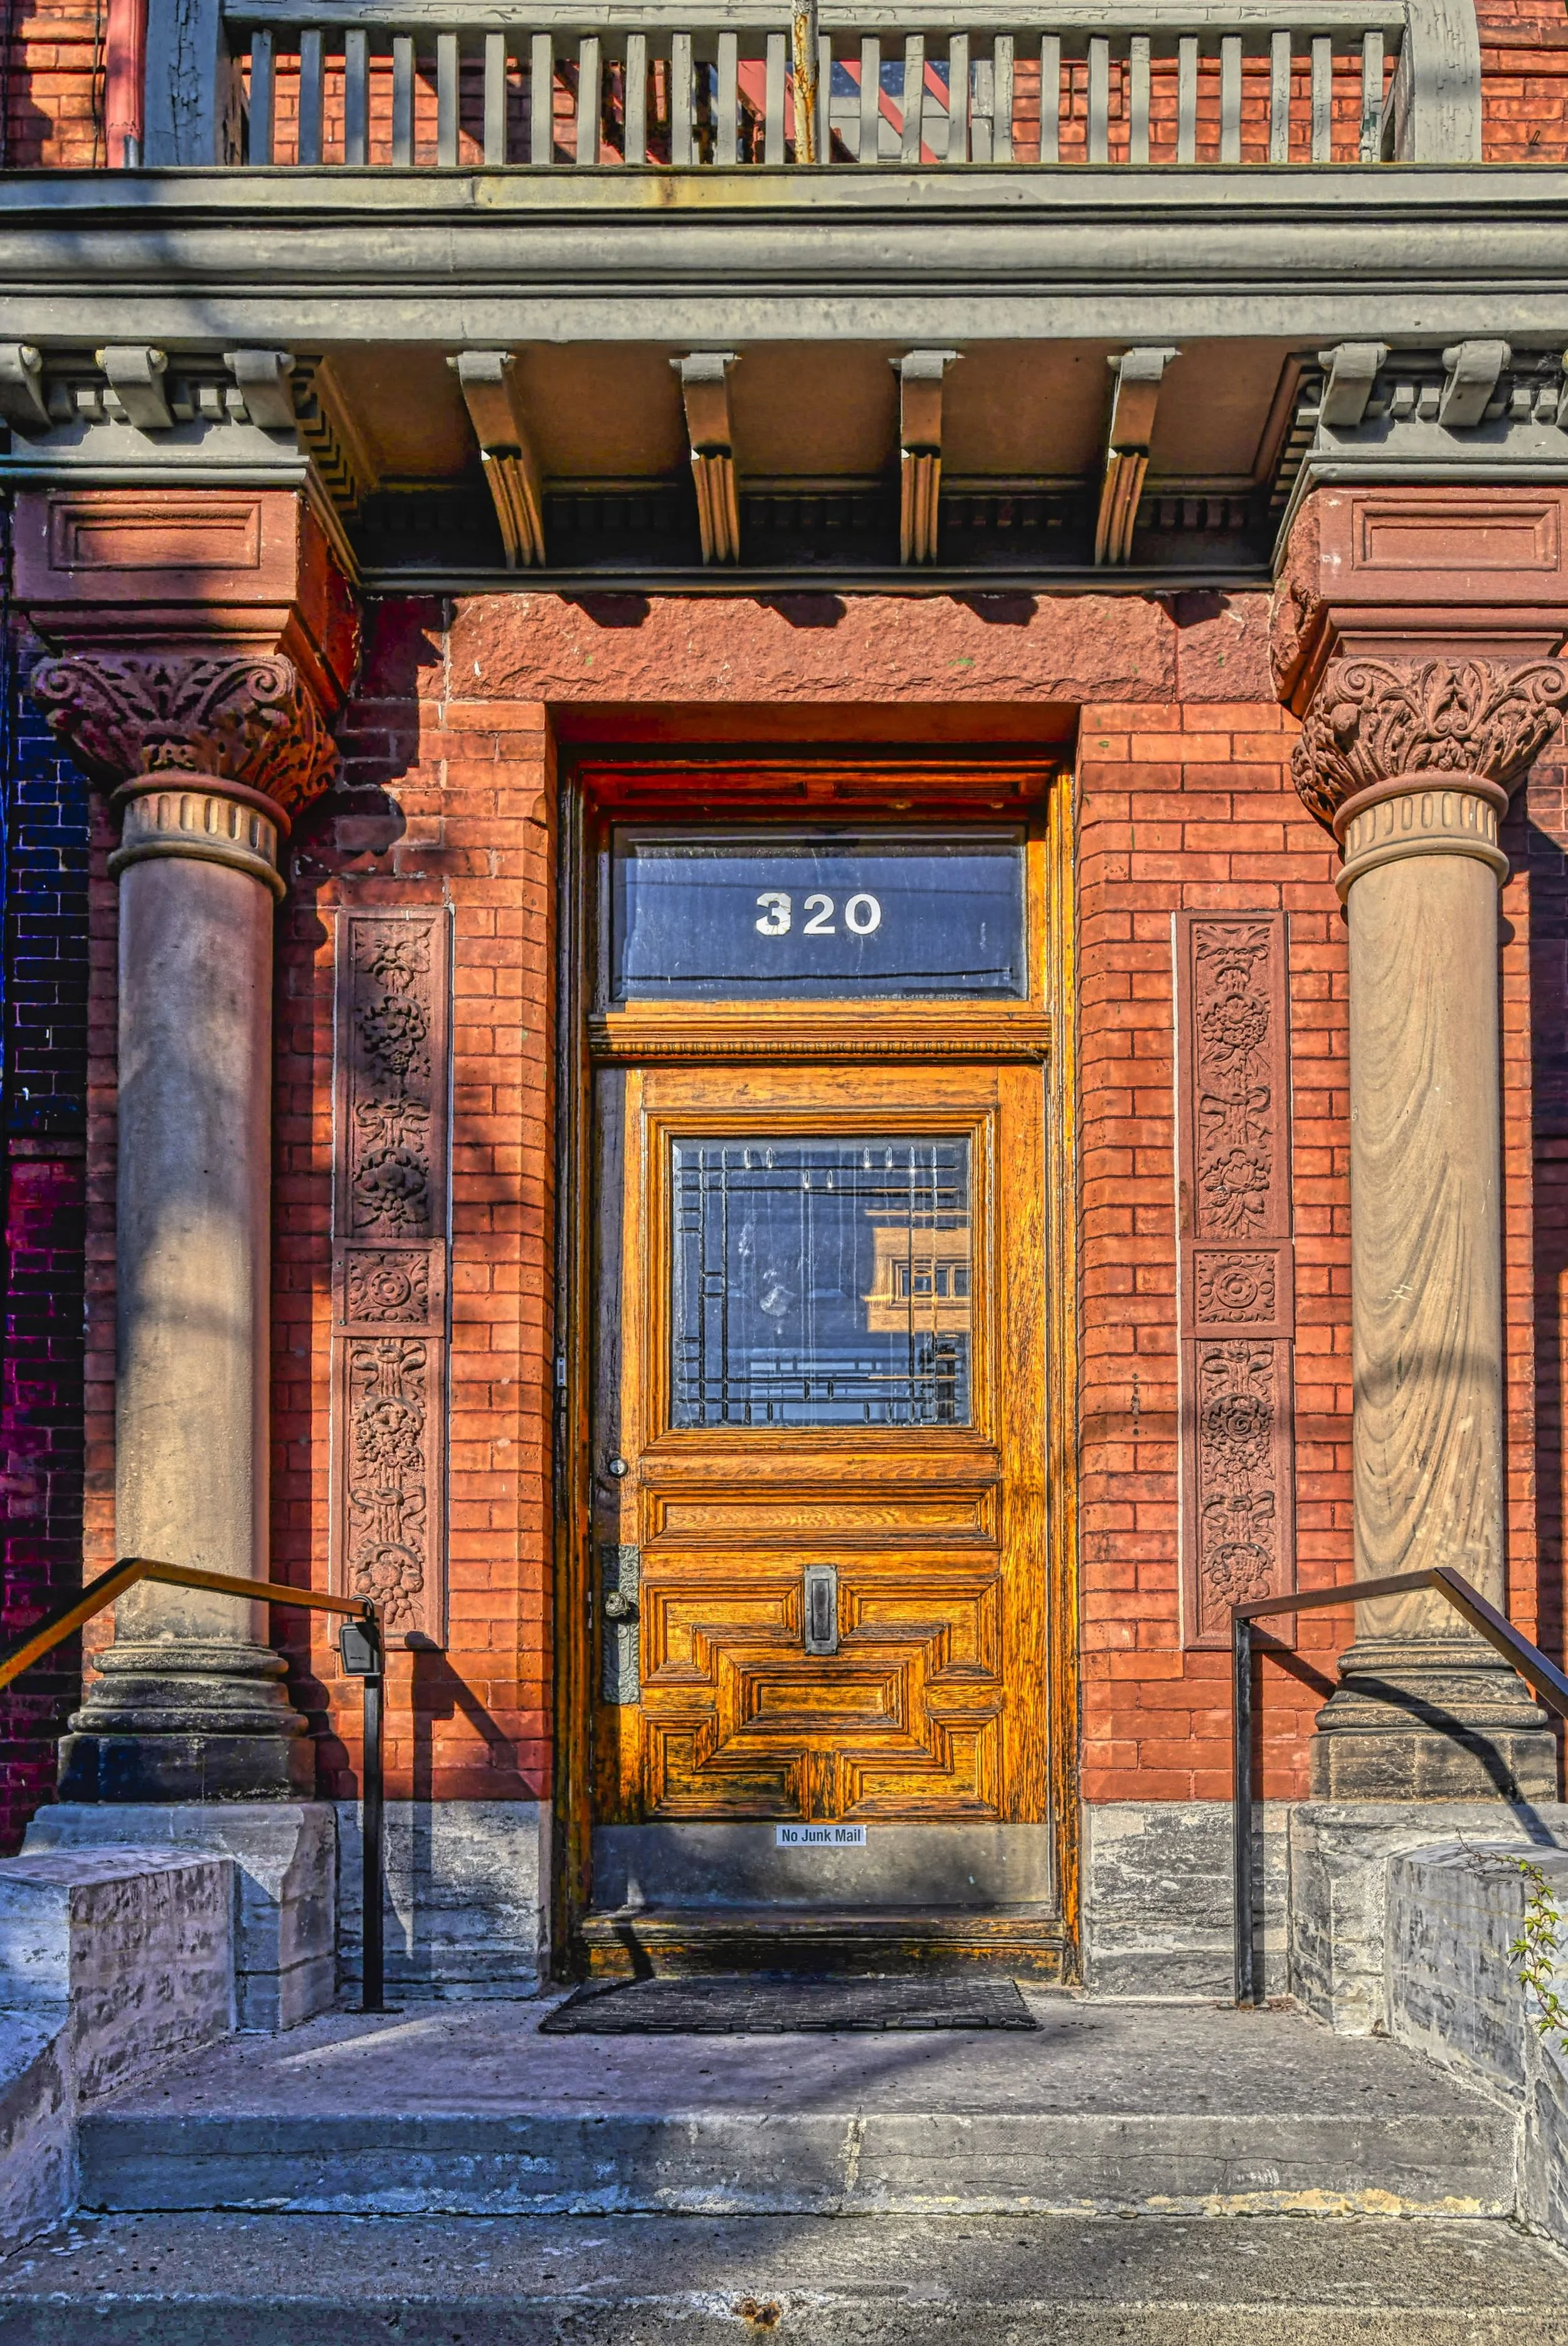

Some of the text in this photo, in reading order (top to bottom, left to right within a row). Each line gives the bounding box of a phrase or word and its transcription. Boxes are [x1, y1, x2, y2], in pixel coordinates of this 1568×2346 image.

[756, 892, 882, 935] 320
[781, 1829, 861, 1842] No Junk Mail
